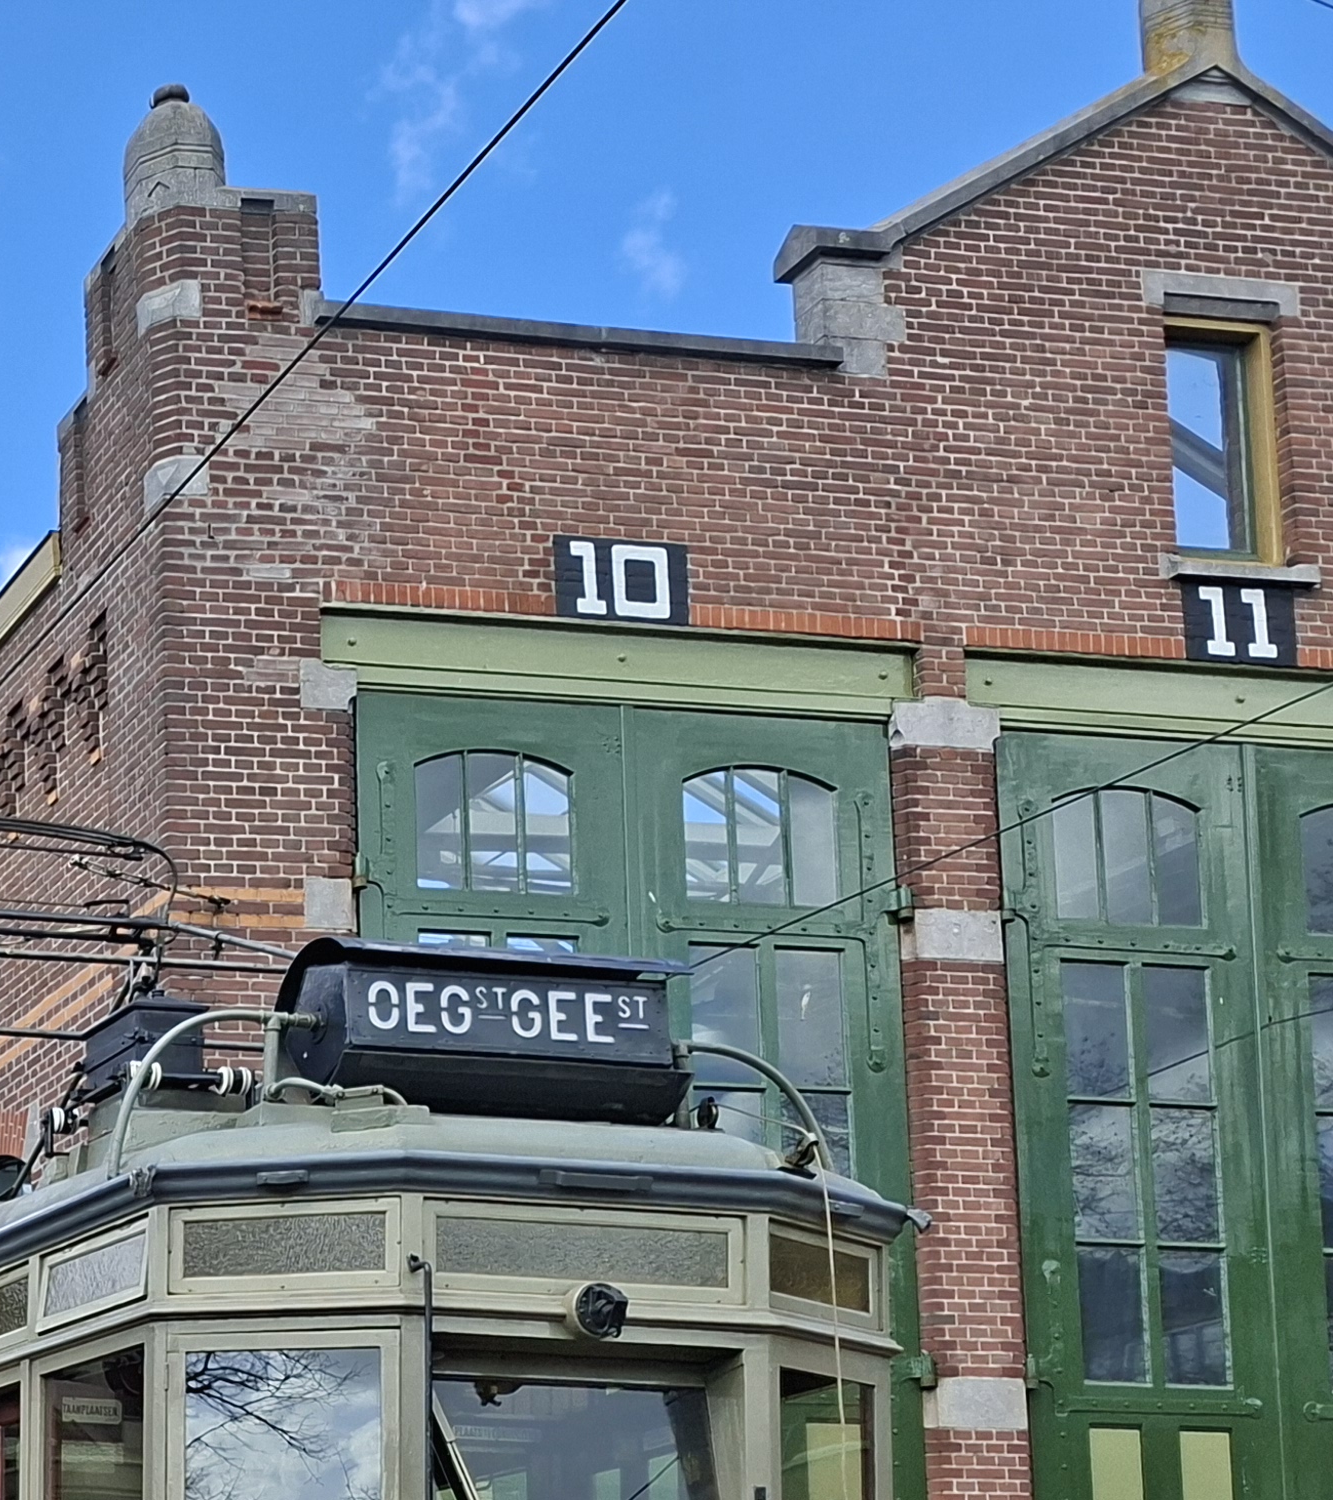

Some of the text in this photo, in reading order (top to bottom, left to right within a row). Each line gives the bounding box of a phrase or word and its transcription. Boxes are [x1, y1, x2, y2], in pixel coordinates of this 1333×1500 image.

[569, 540, 671, 619] 10
[1198, 586, 1278, 658] 11
[367, 979, 650, 1044] OEGSTGEEST
